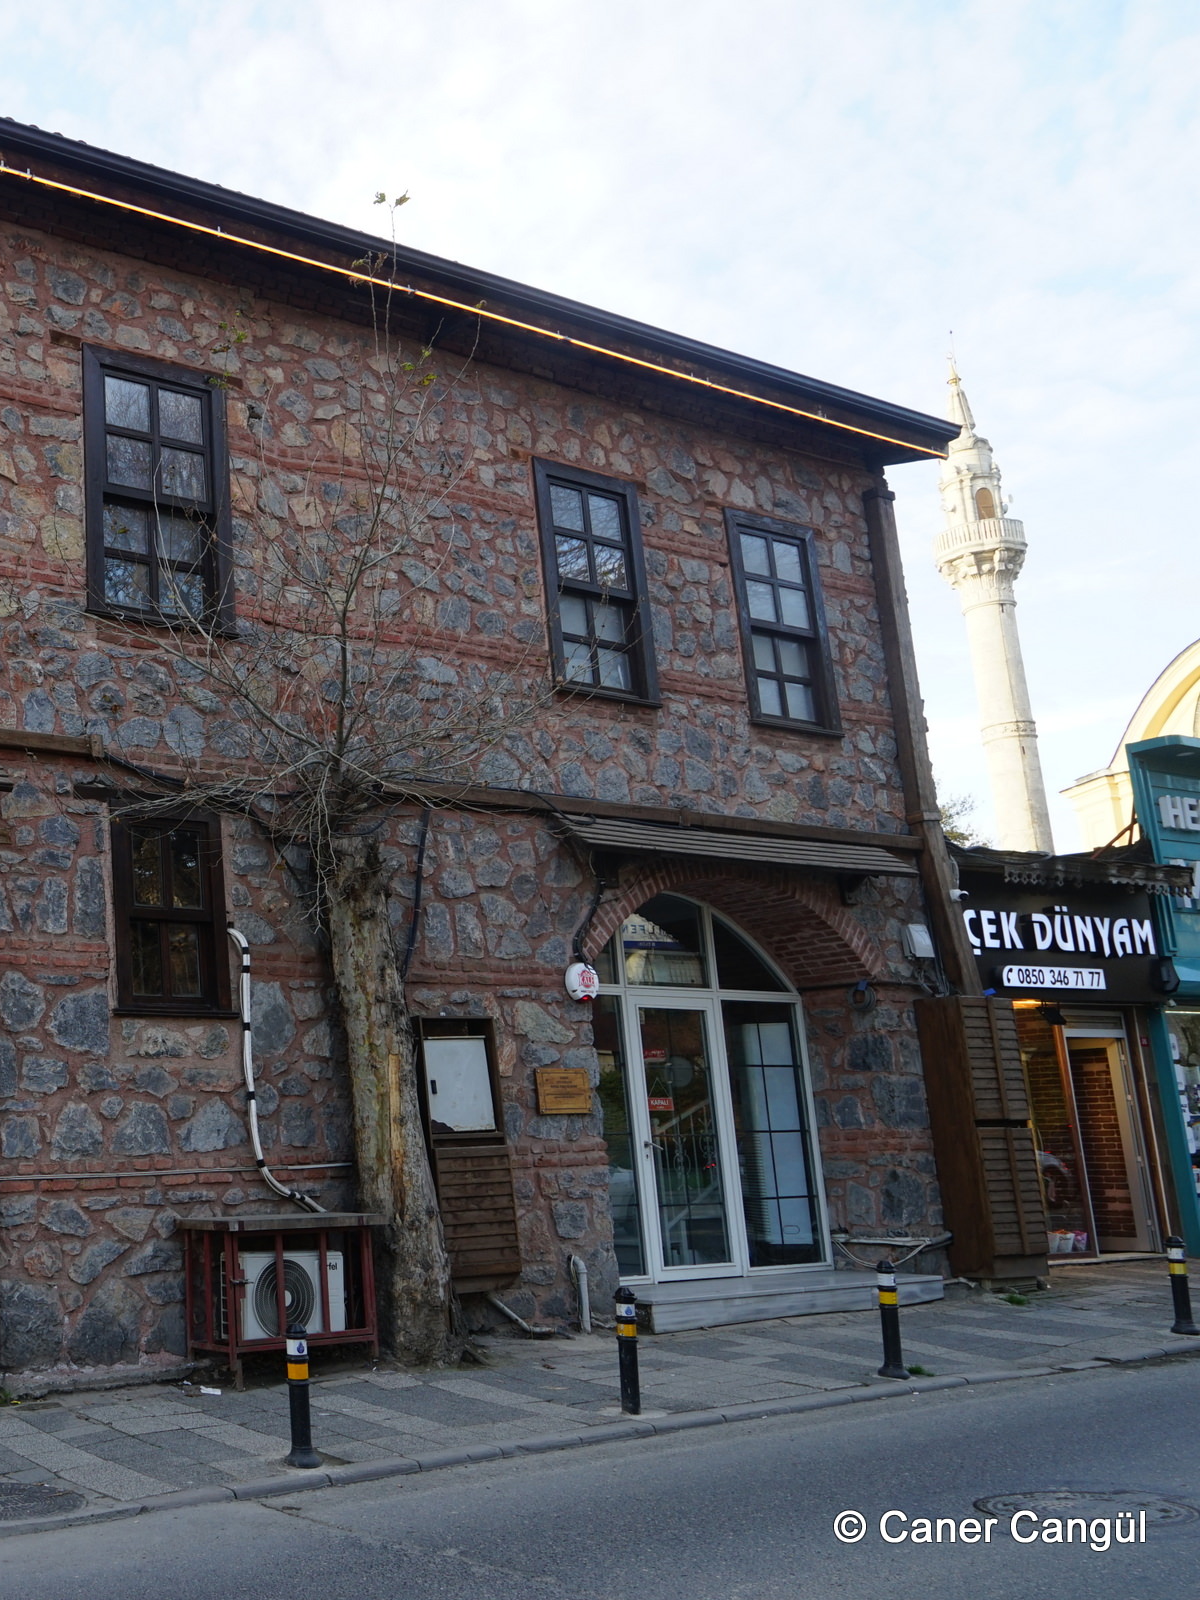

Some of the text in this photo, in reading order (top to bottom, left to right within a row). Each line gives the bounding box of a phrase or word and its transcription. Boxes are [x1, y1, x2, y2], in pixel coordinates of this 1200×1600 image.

[963, 905, 1156, 958] ÇEK DÜNYAM
[1017, 969, 1101, 987] 0850 346 71 77
